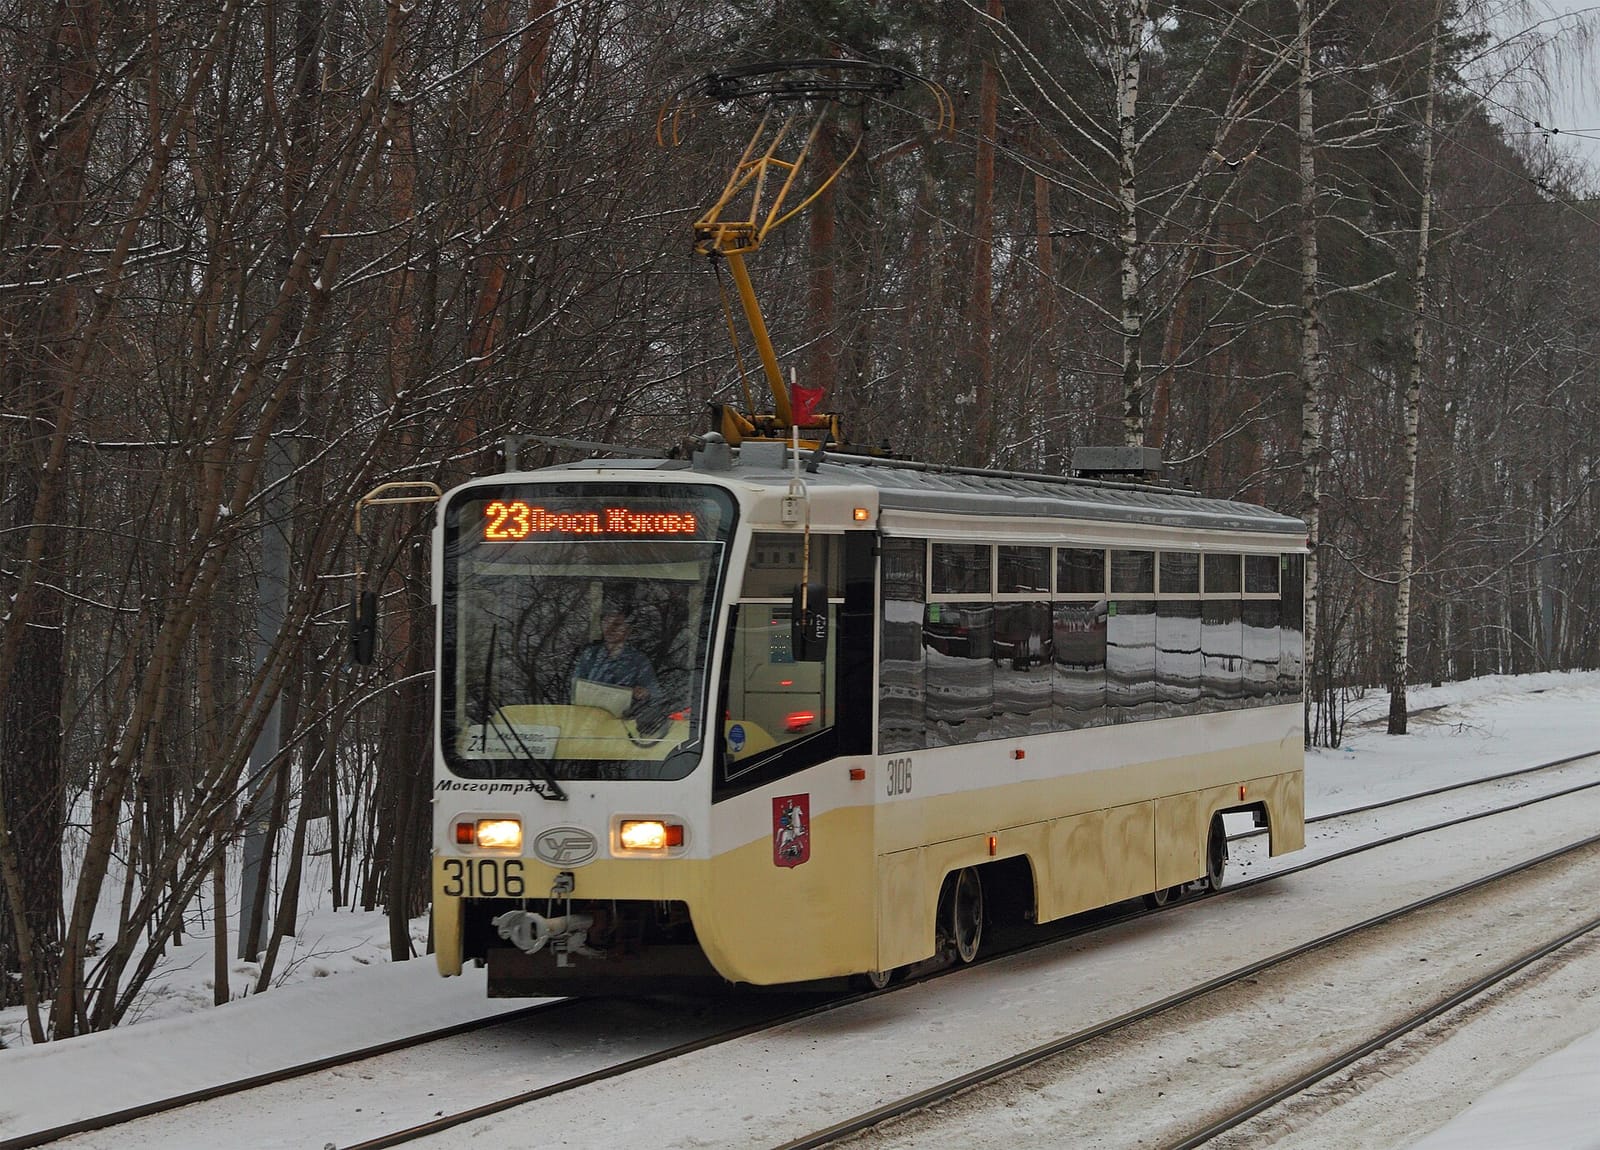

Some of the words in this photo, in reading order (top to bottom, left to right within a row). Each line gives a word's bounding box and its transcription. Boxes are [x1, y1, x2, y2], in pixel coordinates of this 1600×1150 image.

[485, 502, 530, 538] 23
[531, 508, 604, 533] Просп.
[606, 508, 696, 533] Жукова
[887, 757, 912, 796] 3106
[443, 859, 524, 897] 3106
